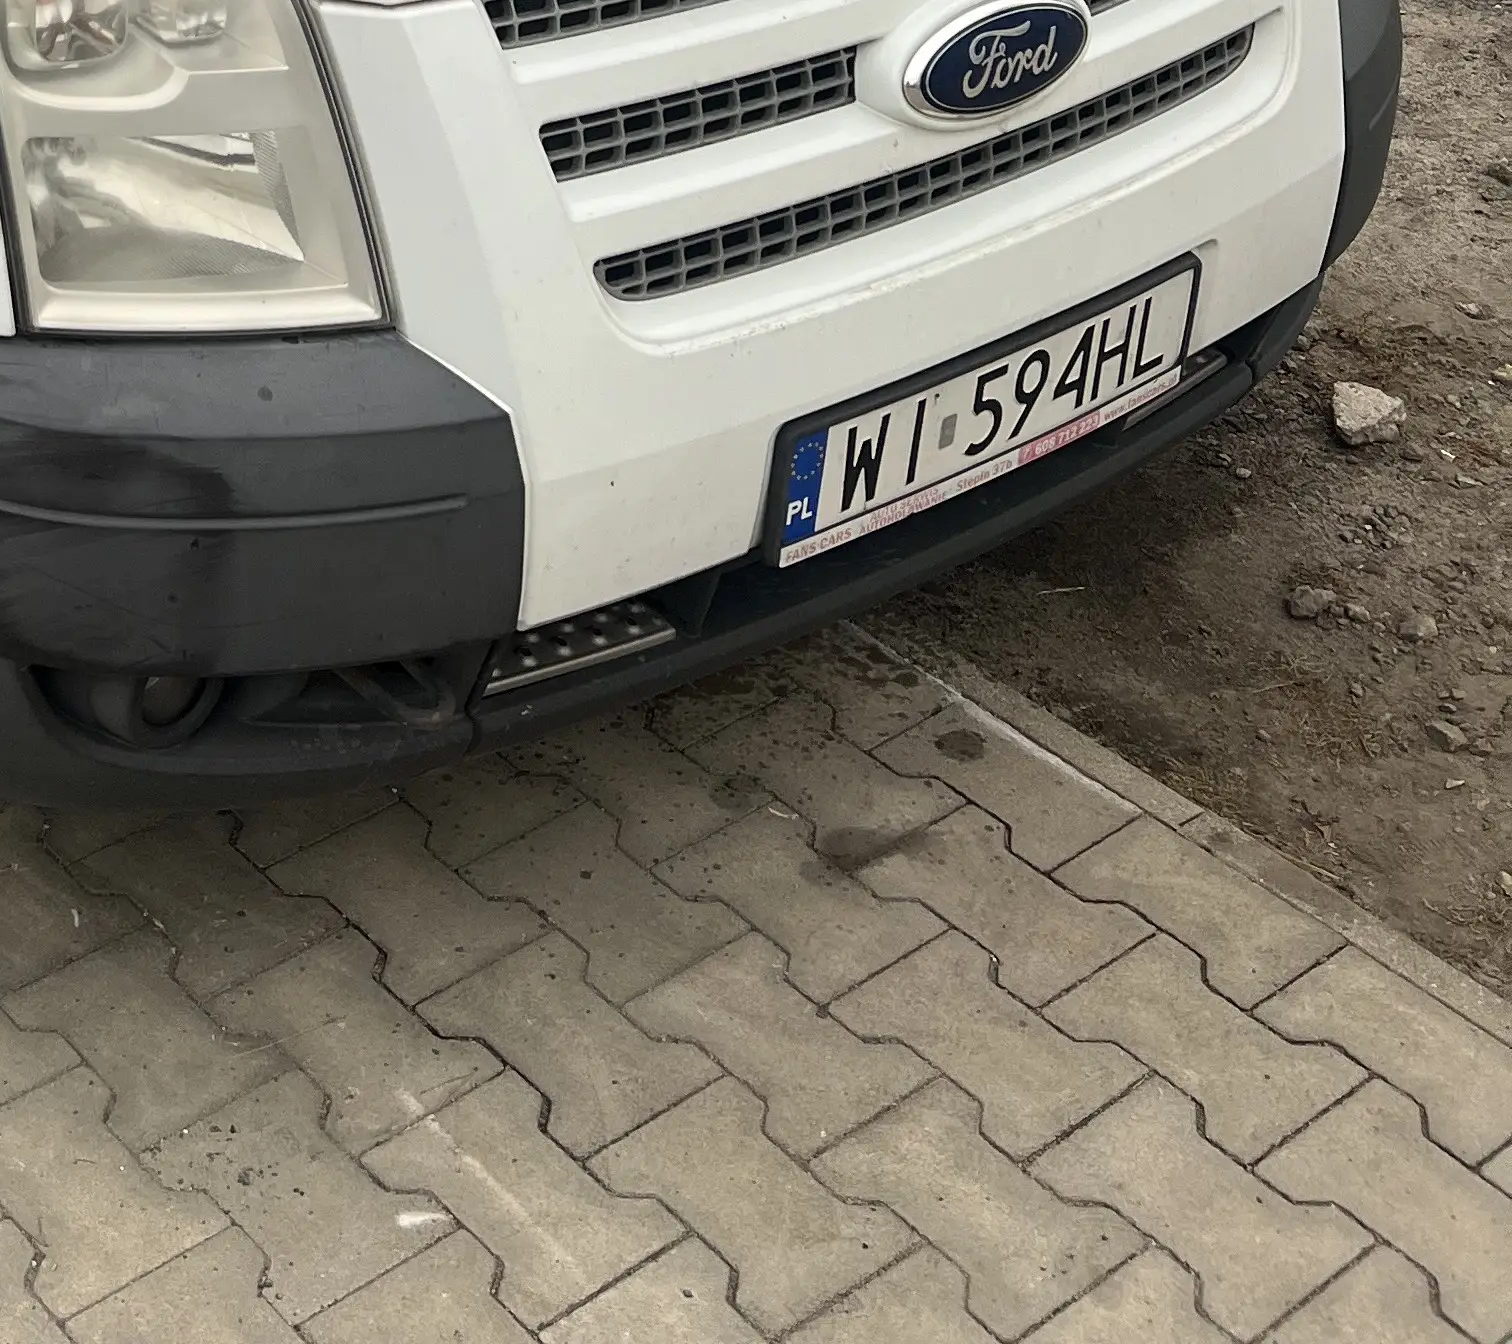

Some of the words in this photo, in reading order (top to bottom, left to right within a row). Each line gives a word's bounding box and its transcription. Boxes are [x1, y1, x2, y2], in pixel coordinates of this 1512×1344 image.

[962, 20, 1059, 98] Ford
[839, 398, 927, 513] WI
[964, 296, 1164, 457] 594HL
[1057, 425, 1078, 445] 712
[785, 496, 813, 526] PL
[786, 541, 816, 563] FANS
[819, 527, 852, 550] CARS
